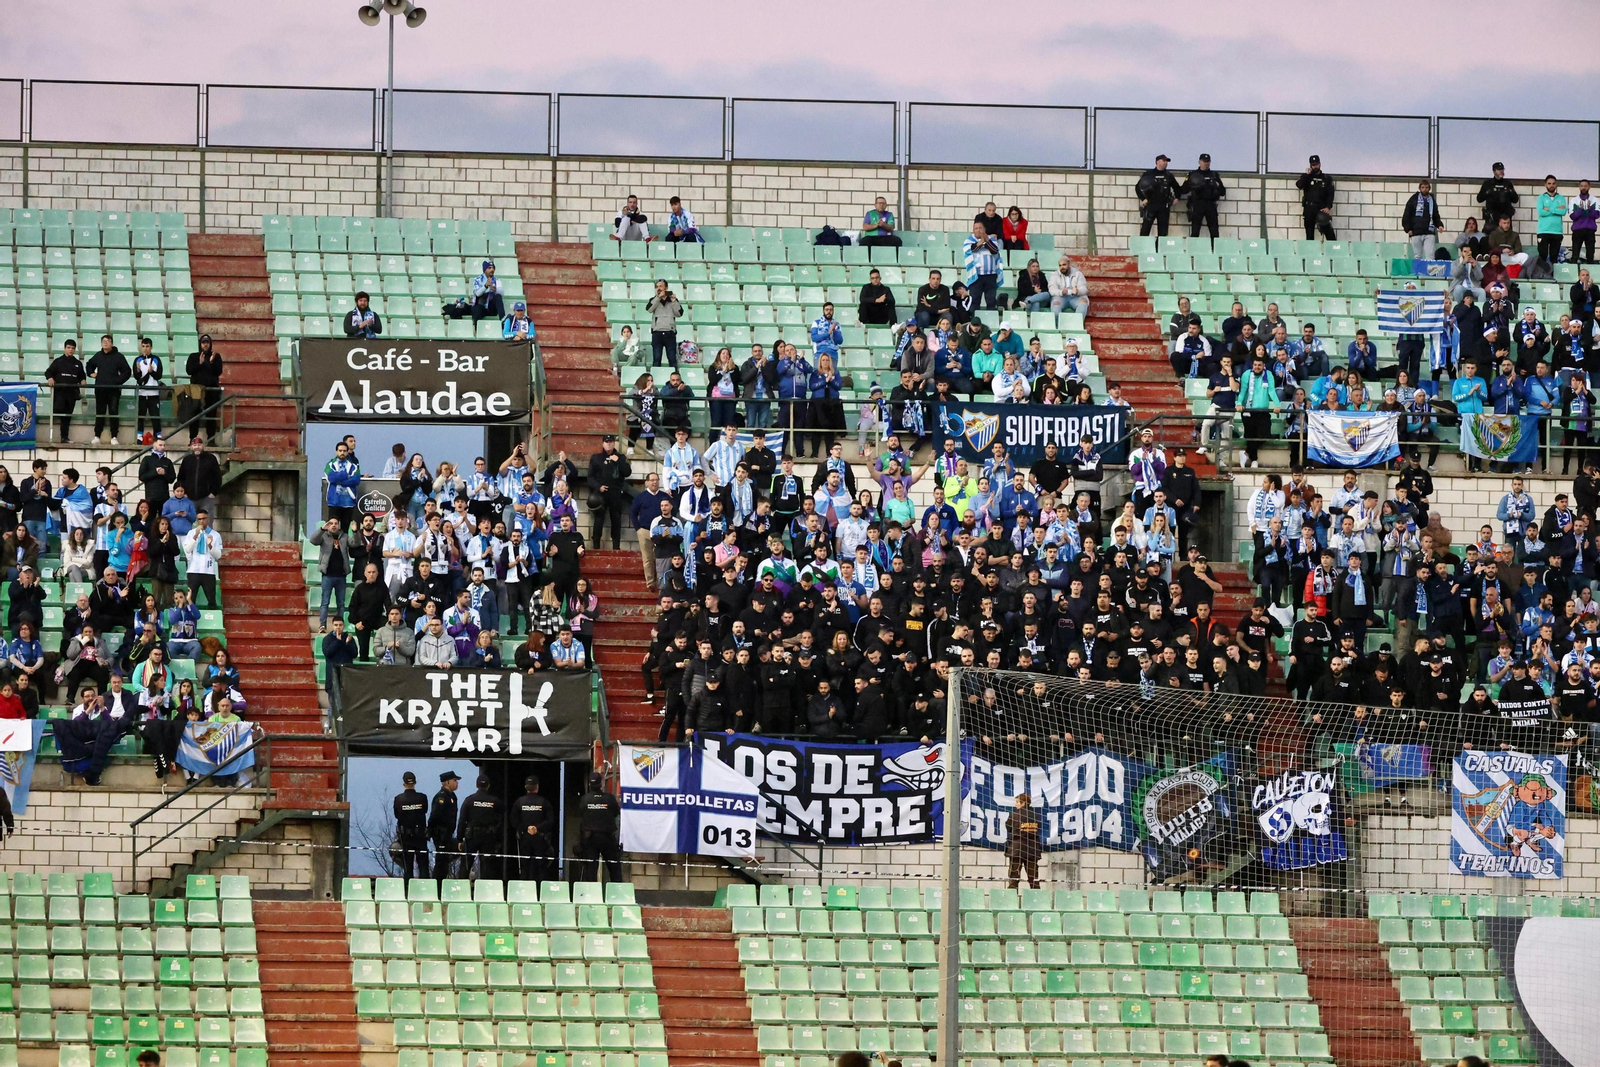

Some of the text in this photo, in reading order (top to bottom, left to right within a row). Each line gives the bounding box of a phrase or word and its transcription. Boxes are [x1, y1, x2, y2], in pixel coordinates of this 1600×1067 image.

[346, 347, 413, 371] Café
[438, 349, 489, 372] Bar
[318, 379, 511, 416] Alaudae
[1005, 413, 1120, 447] SUPERBASTI
[425, 673, 502, 699] THE
[379, 699, 503, 726] KRAFT
[1511, 708, 1548, 718] MALTRATO
[1523, 699, 1550, 708] CONTRA
[1512, 718, 1540, 727] ANIMAL
[431, 727, 501, 753] BAR
[811, 753, 875, 795] DE
[1464, 753, 1555, 775] CASUALS
[970, 751, 1125, 808] FONDO
[622, 793, 755, 812] FUENTEOLLETAS
[757, 793, 927, 838] EMPRE
[970, 804, 1124, 846] SU 1904
[1150, 796, 1213, 845] YOUTH
[702, 824, 752, 849] 013
[1457, 852, 1555, 875] TEATINOS
